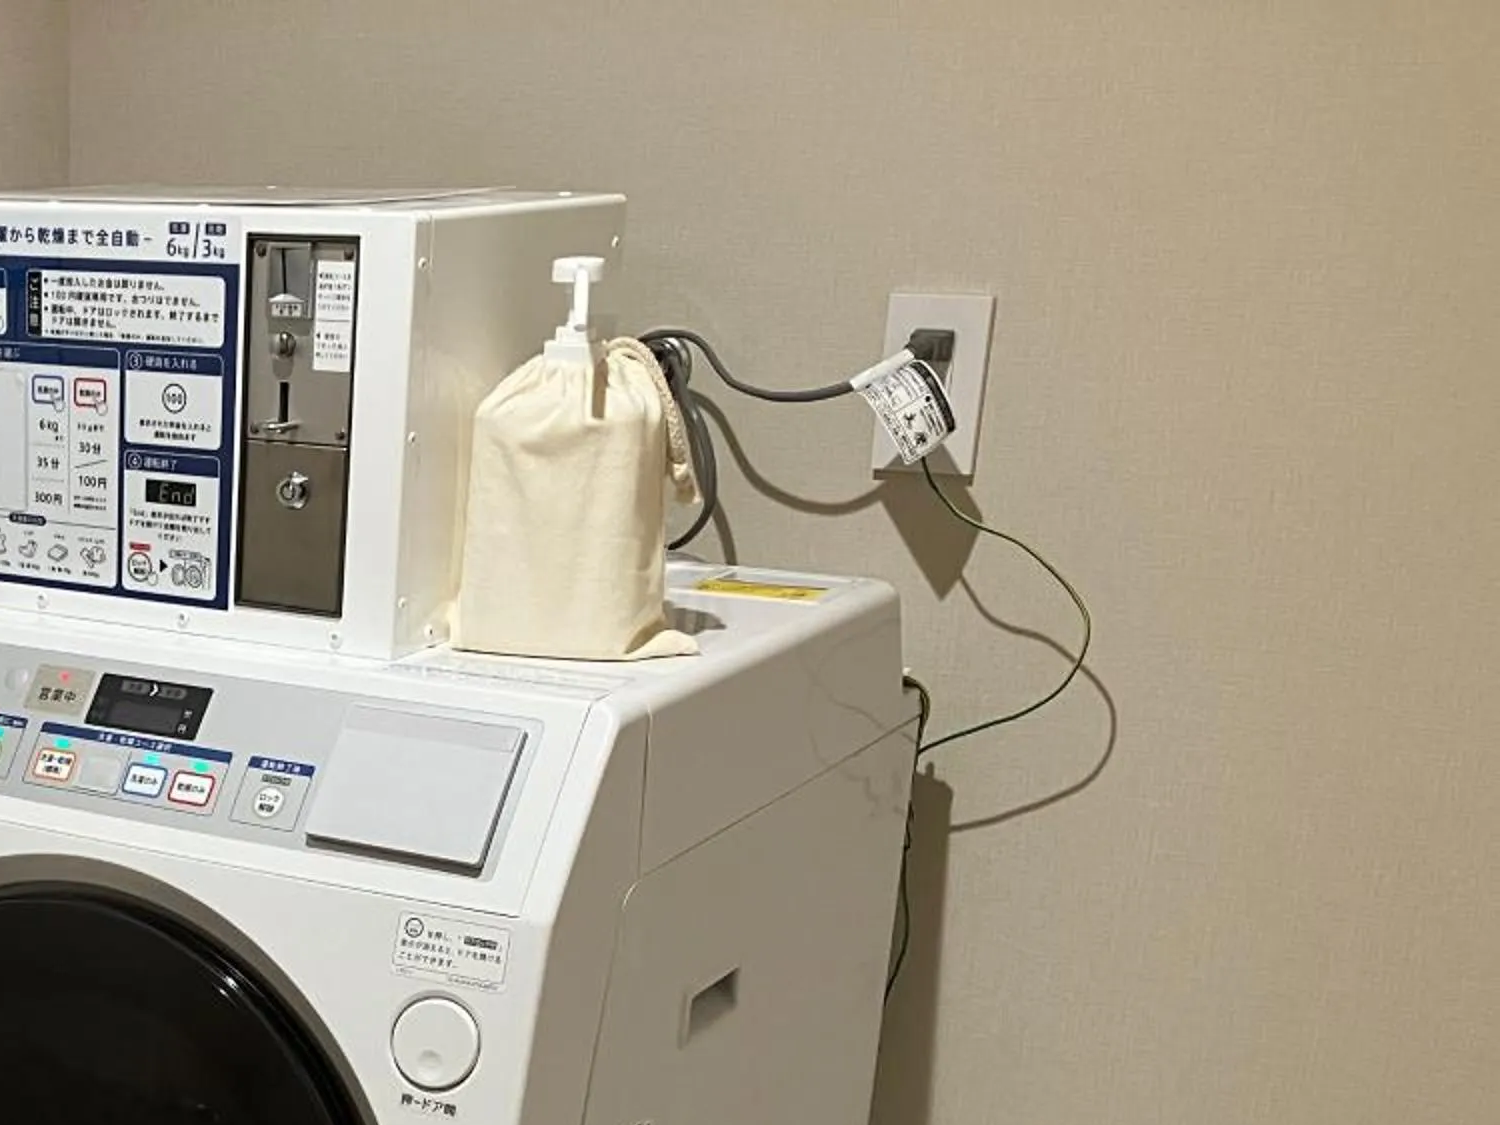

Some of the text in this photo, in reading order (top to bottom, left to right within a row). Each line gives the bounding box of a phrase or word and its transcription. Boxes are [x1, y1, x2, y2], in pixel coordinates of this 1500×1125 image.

[159, 483, 195, 505] End
[37, 686, 78, 702] 営業中
